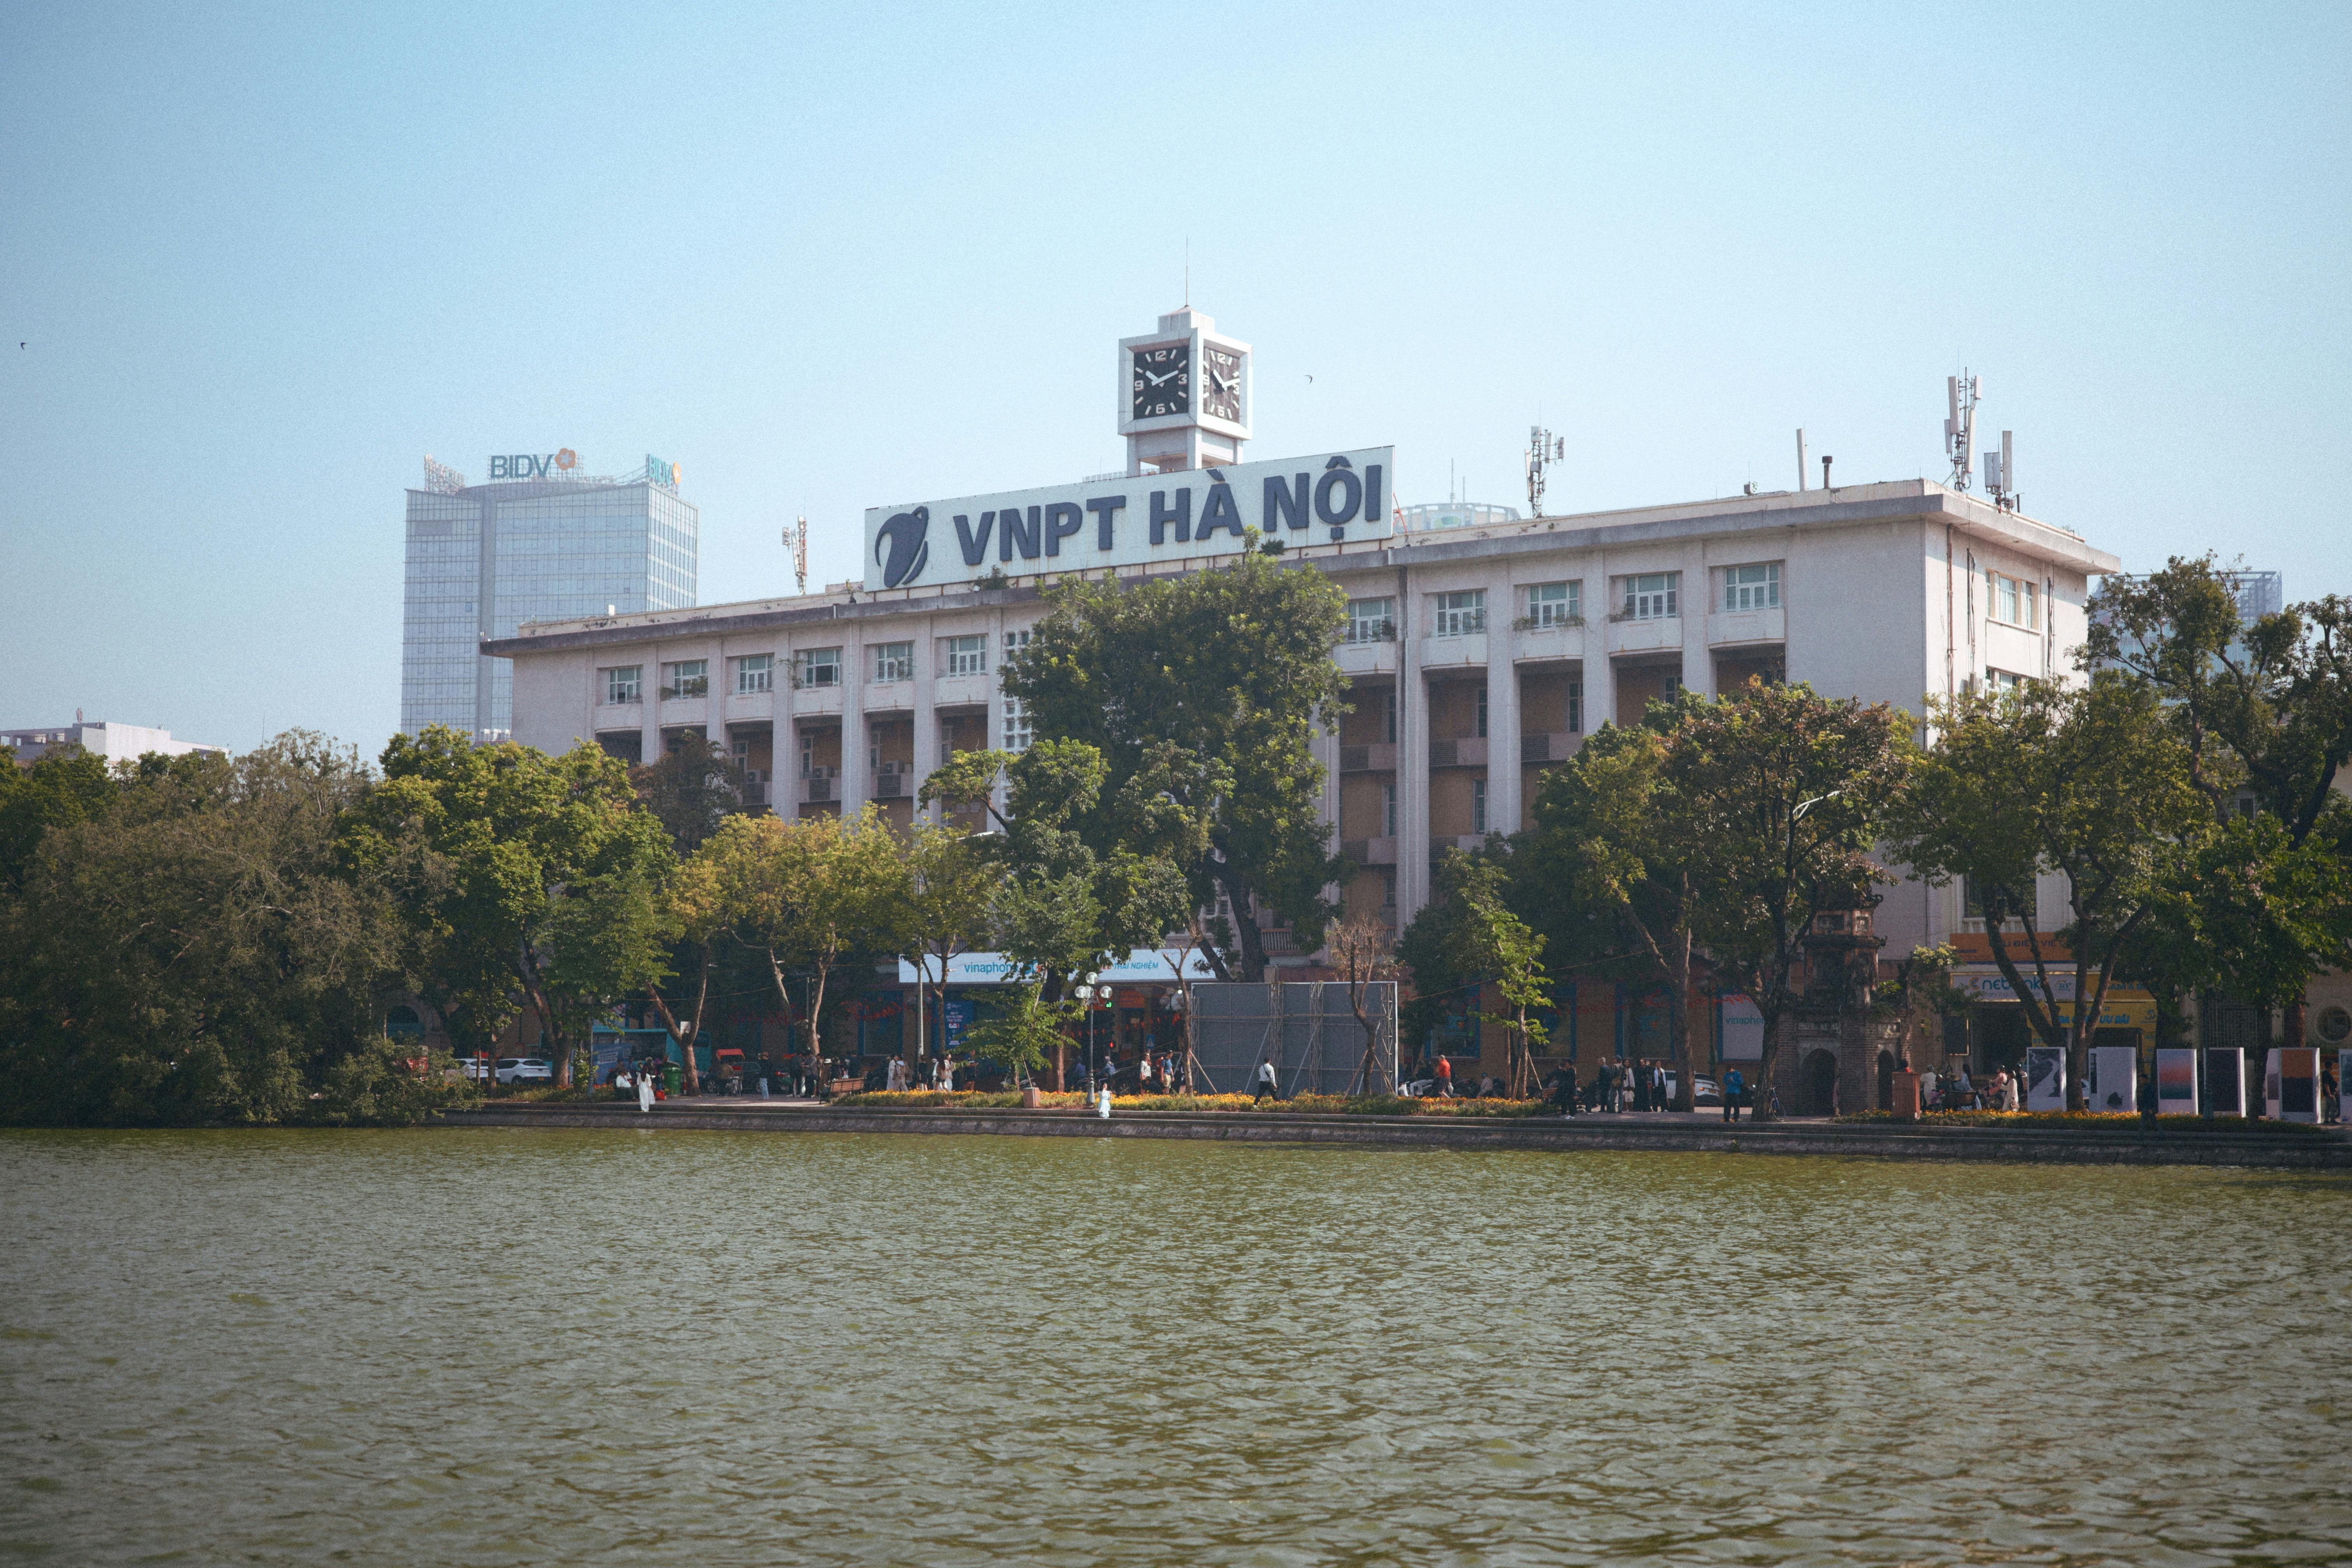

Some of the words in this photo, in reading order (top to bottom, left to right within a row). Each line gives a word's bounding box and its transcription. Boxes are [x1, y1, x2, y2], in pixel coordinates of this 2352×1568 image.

[1155, 350, 1166, 362] 12
[1217, 353, 1225, 364] 12
[1135, 380, 1144, 391] 9
[1178, 374, 1187, 385] 3
[1156, 403, 1166, 415] 6
[1218, 405, 1225, 417] 6
[491, 454, 555, 479] BIDV
[648, 454, 672, 486] BIDV
[952, 495, 1127, 566] VNPT
[1150, 468, 1244, 545] HÀ
[1263, 456, 1382, 540] NỘI
[1131, 960, 1158, 971] NGHIỆM
